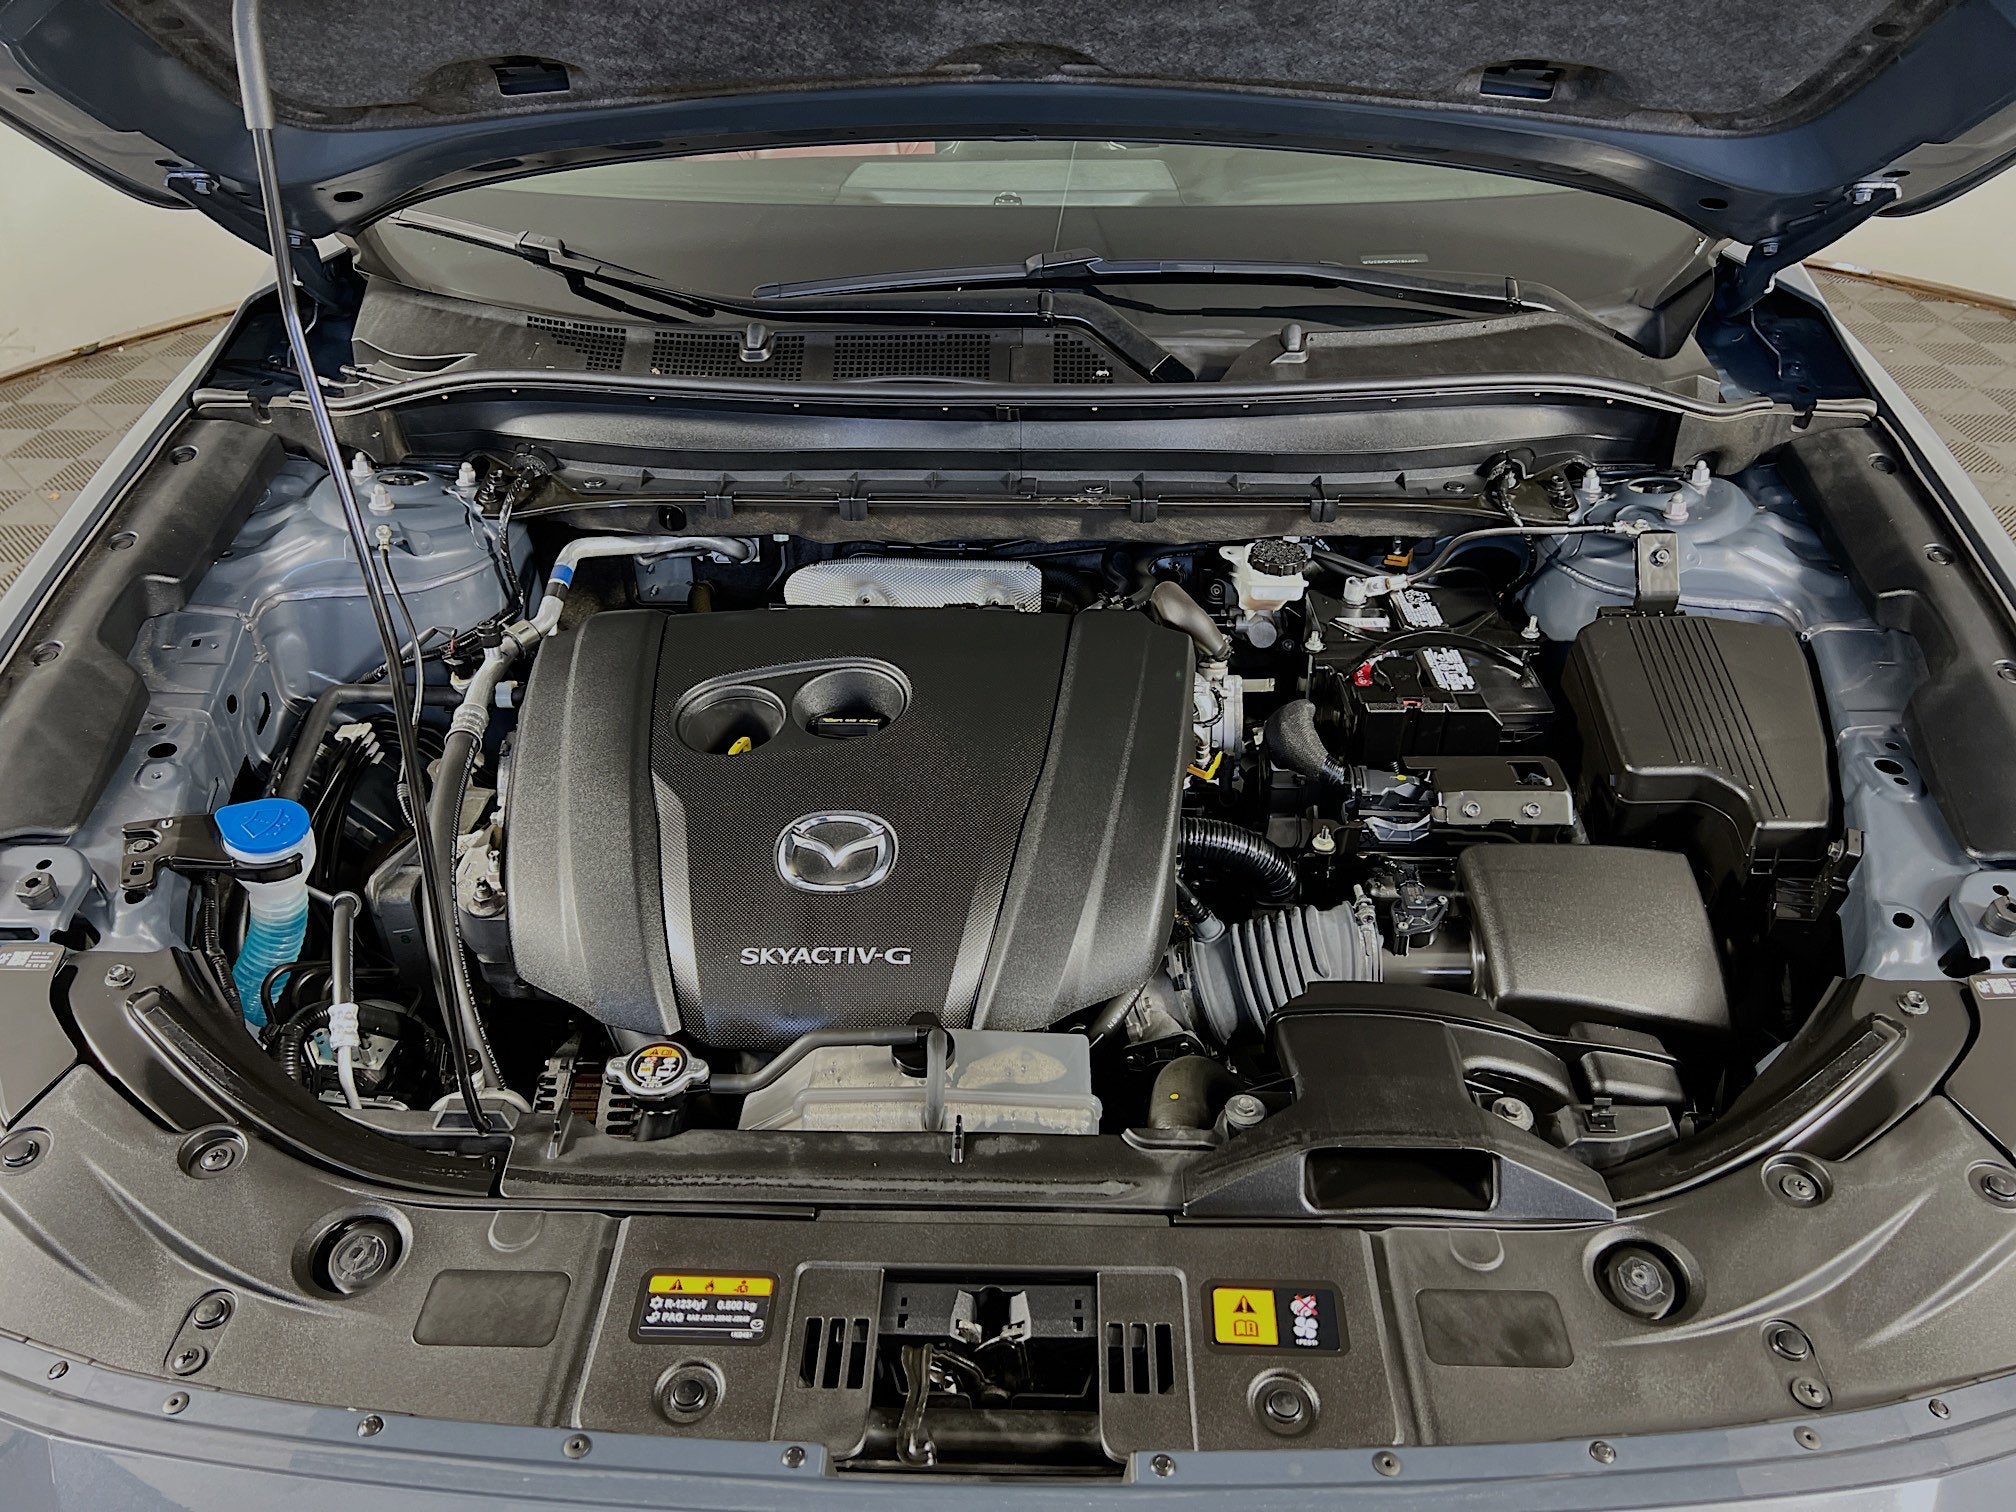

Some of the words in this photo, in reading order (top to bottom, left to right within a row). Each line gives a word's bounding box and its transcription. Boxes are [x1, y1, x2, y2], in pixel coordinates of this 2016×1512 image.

[740, 946, 912, 965] SKYACTIV-G
[485, 1044, 501, 1074] GALAXY
[664, 1298, 708, 1312] R-1234yf
[716, 1299, 743, 1311] 0.500
[743, 1300, 758, 1313] kg
[661, 1311, 685, 1323] PAG
